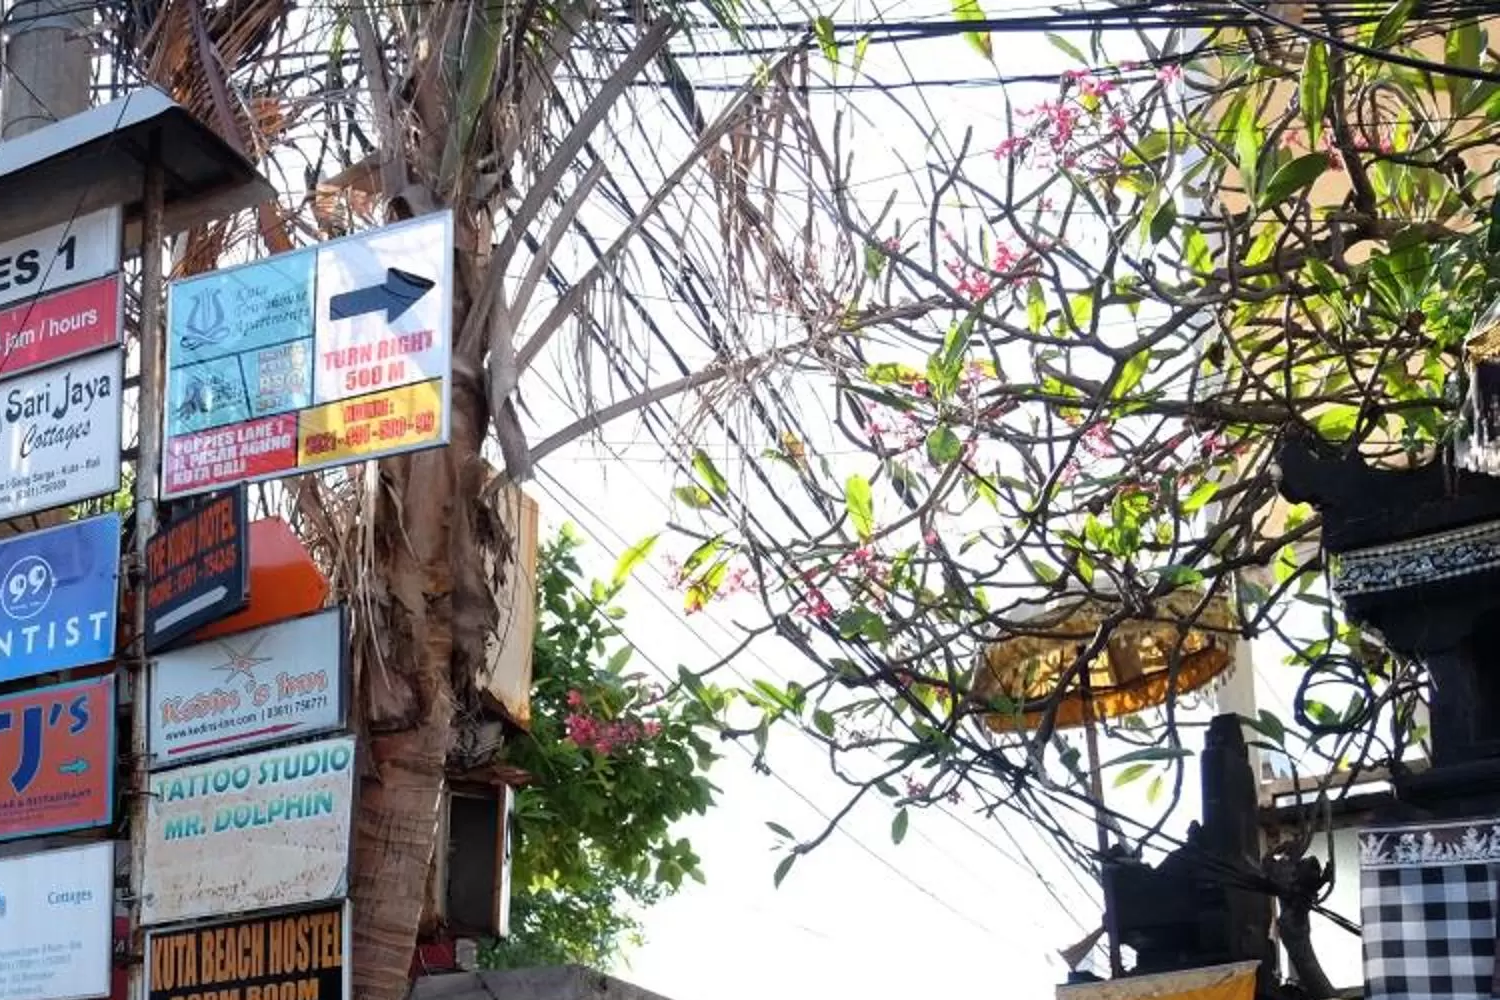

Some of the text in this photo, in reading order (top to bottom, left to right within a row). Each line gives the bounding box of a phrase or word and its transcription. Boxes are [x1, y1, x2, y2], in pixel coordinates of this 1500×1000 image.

[58, 236, 77, 270] 1
[3, 323, 36, 356] jam
[49, 306, 99, 337] hours
[323, 329, 434, 371] TURN RIGHT
[346, 361, 404, 390] 500 M
[5, 371, 111, 423] Sari Jaya
[20, 419, 91, 459] Cottages
[174, 431, 236, 457] POPPIES
[237, 423, 273, 442] LANE
[9, 565, 47, 603] 99
[156, 745, 350, 802] TATTOO STUDIO
[164, 791, 333, 841] MR. DOLPHIN
[48, 888, 93, 906] Cottages
[151, 933, 197, 991] KUTA
[201, 923, 264, 984] BEACH
[269, 911, 342, 975] HOSTEL
